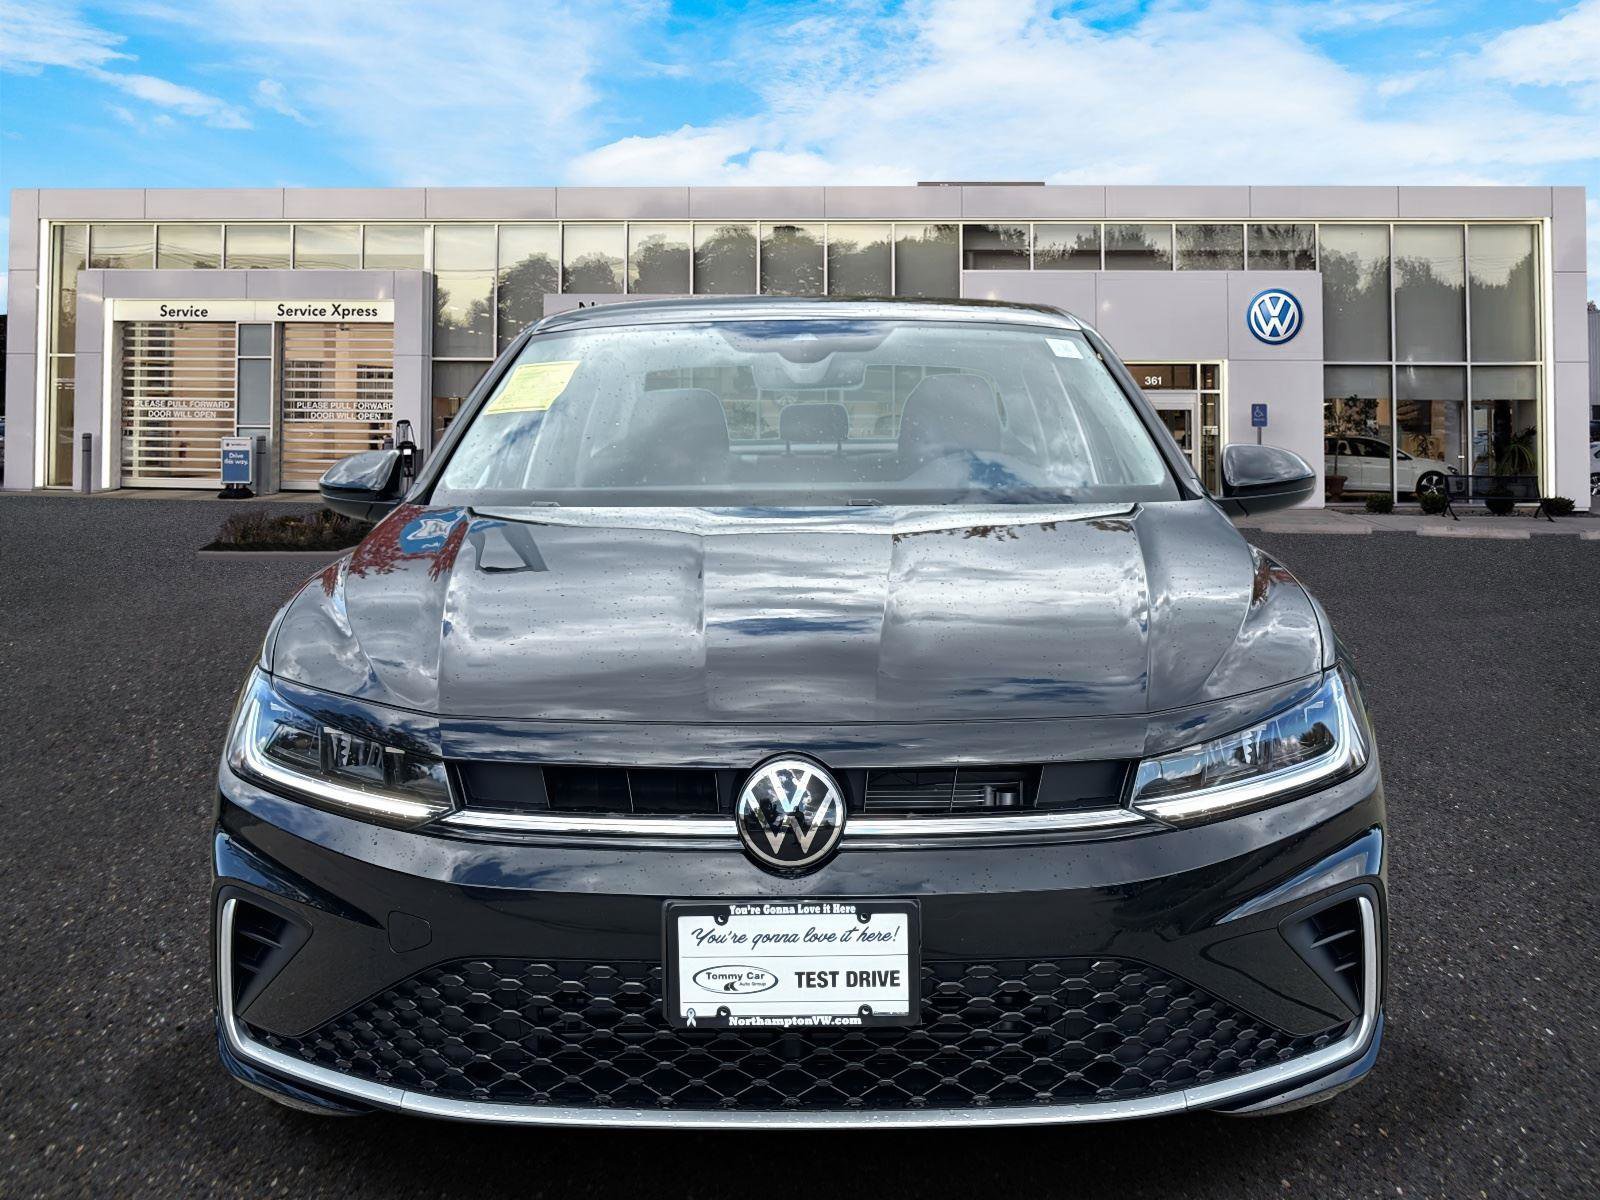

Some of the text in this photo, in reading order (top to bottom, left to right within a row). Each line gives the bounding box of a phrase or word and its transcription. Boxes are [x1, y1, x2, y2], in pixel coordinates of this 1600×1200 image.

[160, 304, 209, 319] Service
[277, 303, 378, 319] Service Xpress
[1144, 376, 1162, 385] 361
[134, 400, 230, 409] PLEASE PULL FORWARD
[296, 401, 394, 410] PLEASE PULL FORWARD
[148, 410, 217, 419] DOOR WILL OPEN
[310, 412, 381, 420] DOOR WILL OPEN
[729, 904, 856, 915] You're Gonna Love it Here
[691, 925, 901, 950] You're gonna love it here!
[706, 971, 765, 982] Tommy Car
[794, 970, 900, 988] TEST DRIVE
[729, 1016, 862, 1027] NorthamptonVW.com
